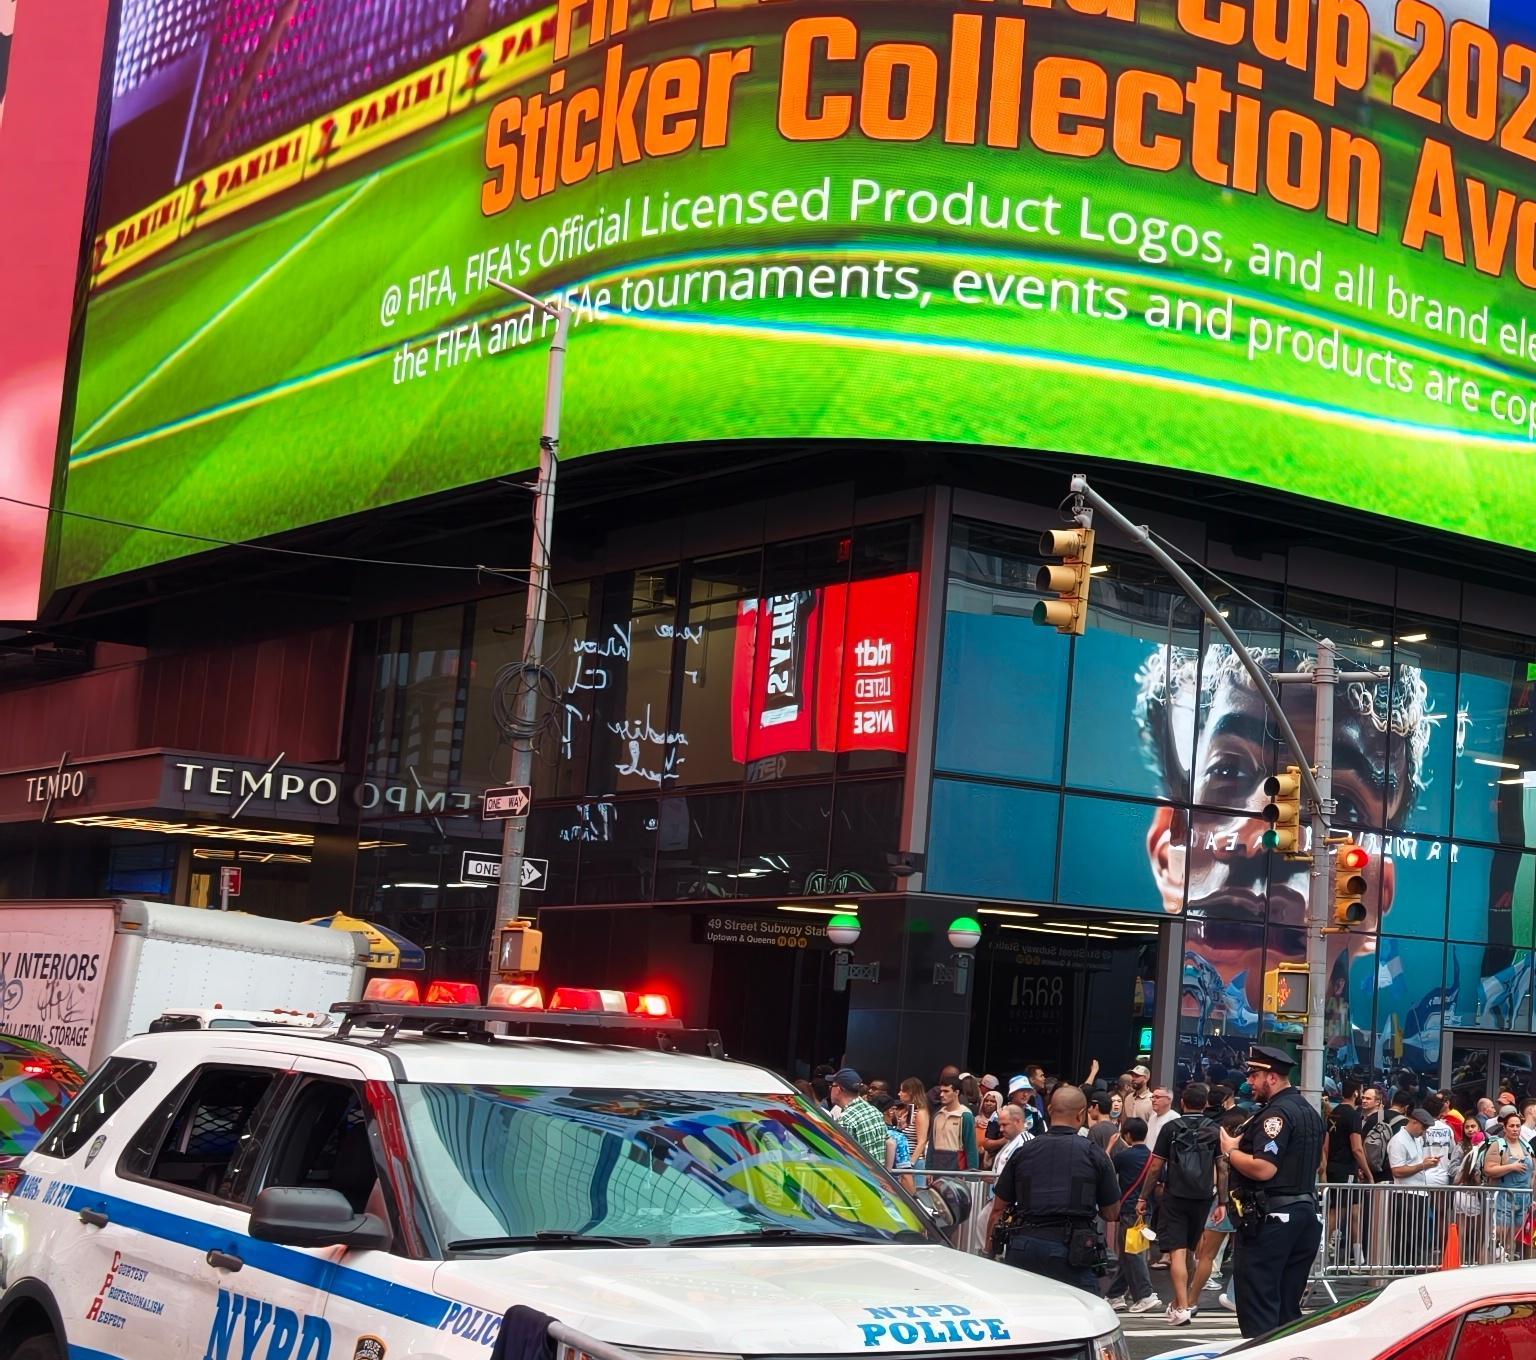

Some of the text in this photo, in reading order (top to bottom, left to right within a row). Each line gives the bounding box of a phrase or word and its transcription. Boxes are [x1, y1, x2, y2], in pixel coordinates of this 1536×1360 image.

[347, 70, 446, 136] PANINI
[480, 42, 753, 218] Sticker
[776, 13, 1383, 234] Collection
[214, 134, 302, 200] PANINI
[112, 192, 182, 256] PANINI
[406, 267, 458, 317] FIFA,
[465, 241, 532, 296] FIFA's
[538, 198, 632, 268] Official
[640, 176, 832, 234] Licensed
[849, 177, 1063, 237] Product
[1078, 195, 1234, 272] Logos,
[1248, 238, 1324, 295] and
[1333, 260, 1376, 313] all
[1388, 274, 1490, 350] brand
[391, 344, 428, 385] the
[434, 324, 482, 372] FIFA
[487, 310, 535, 357] and
[620, 257, 934, 312] tournaments,
[952, 270, 1127, 322] events
[1144, 288, 1234, 343] and
[1247, 318, 1414, 398] products
[1425, 370, 1481, 414] are
[26, 752, 84, 823] TEMPO
[176, 752, 338, 819] TEMPO
[488, 796, 524, 810] ONE WAY
[475, 862, 500, 876] ONE
[707, 933, 738, 944] Uptown
[747, 936, 776, 945] Queens
[708, 918, 828, 937] 49 Street Subway Stat
[14, 952, 99, 982] INTERIORS
[1010, 975, 1063, 1006] 1568
[48, 1026, 89, 1047] STORAGE
[111, 1250, 149, 1283] COURTESY
[99, 1273, 166, 1317] PROFESSIONALISM
[86, 1297, 126, 1330] RESPECT
[441, 1301, 500, 1348] POLIC
[863, 1304, 970, 1320] NYPD
[857, 1319, 1011, 1346] POLICE
